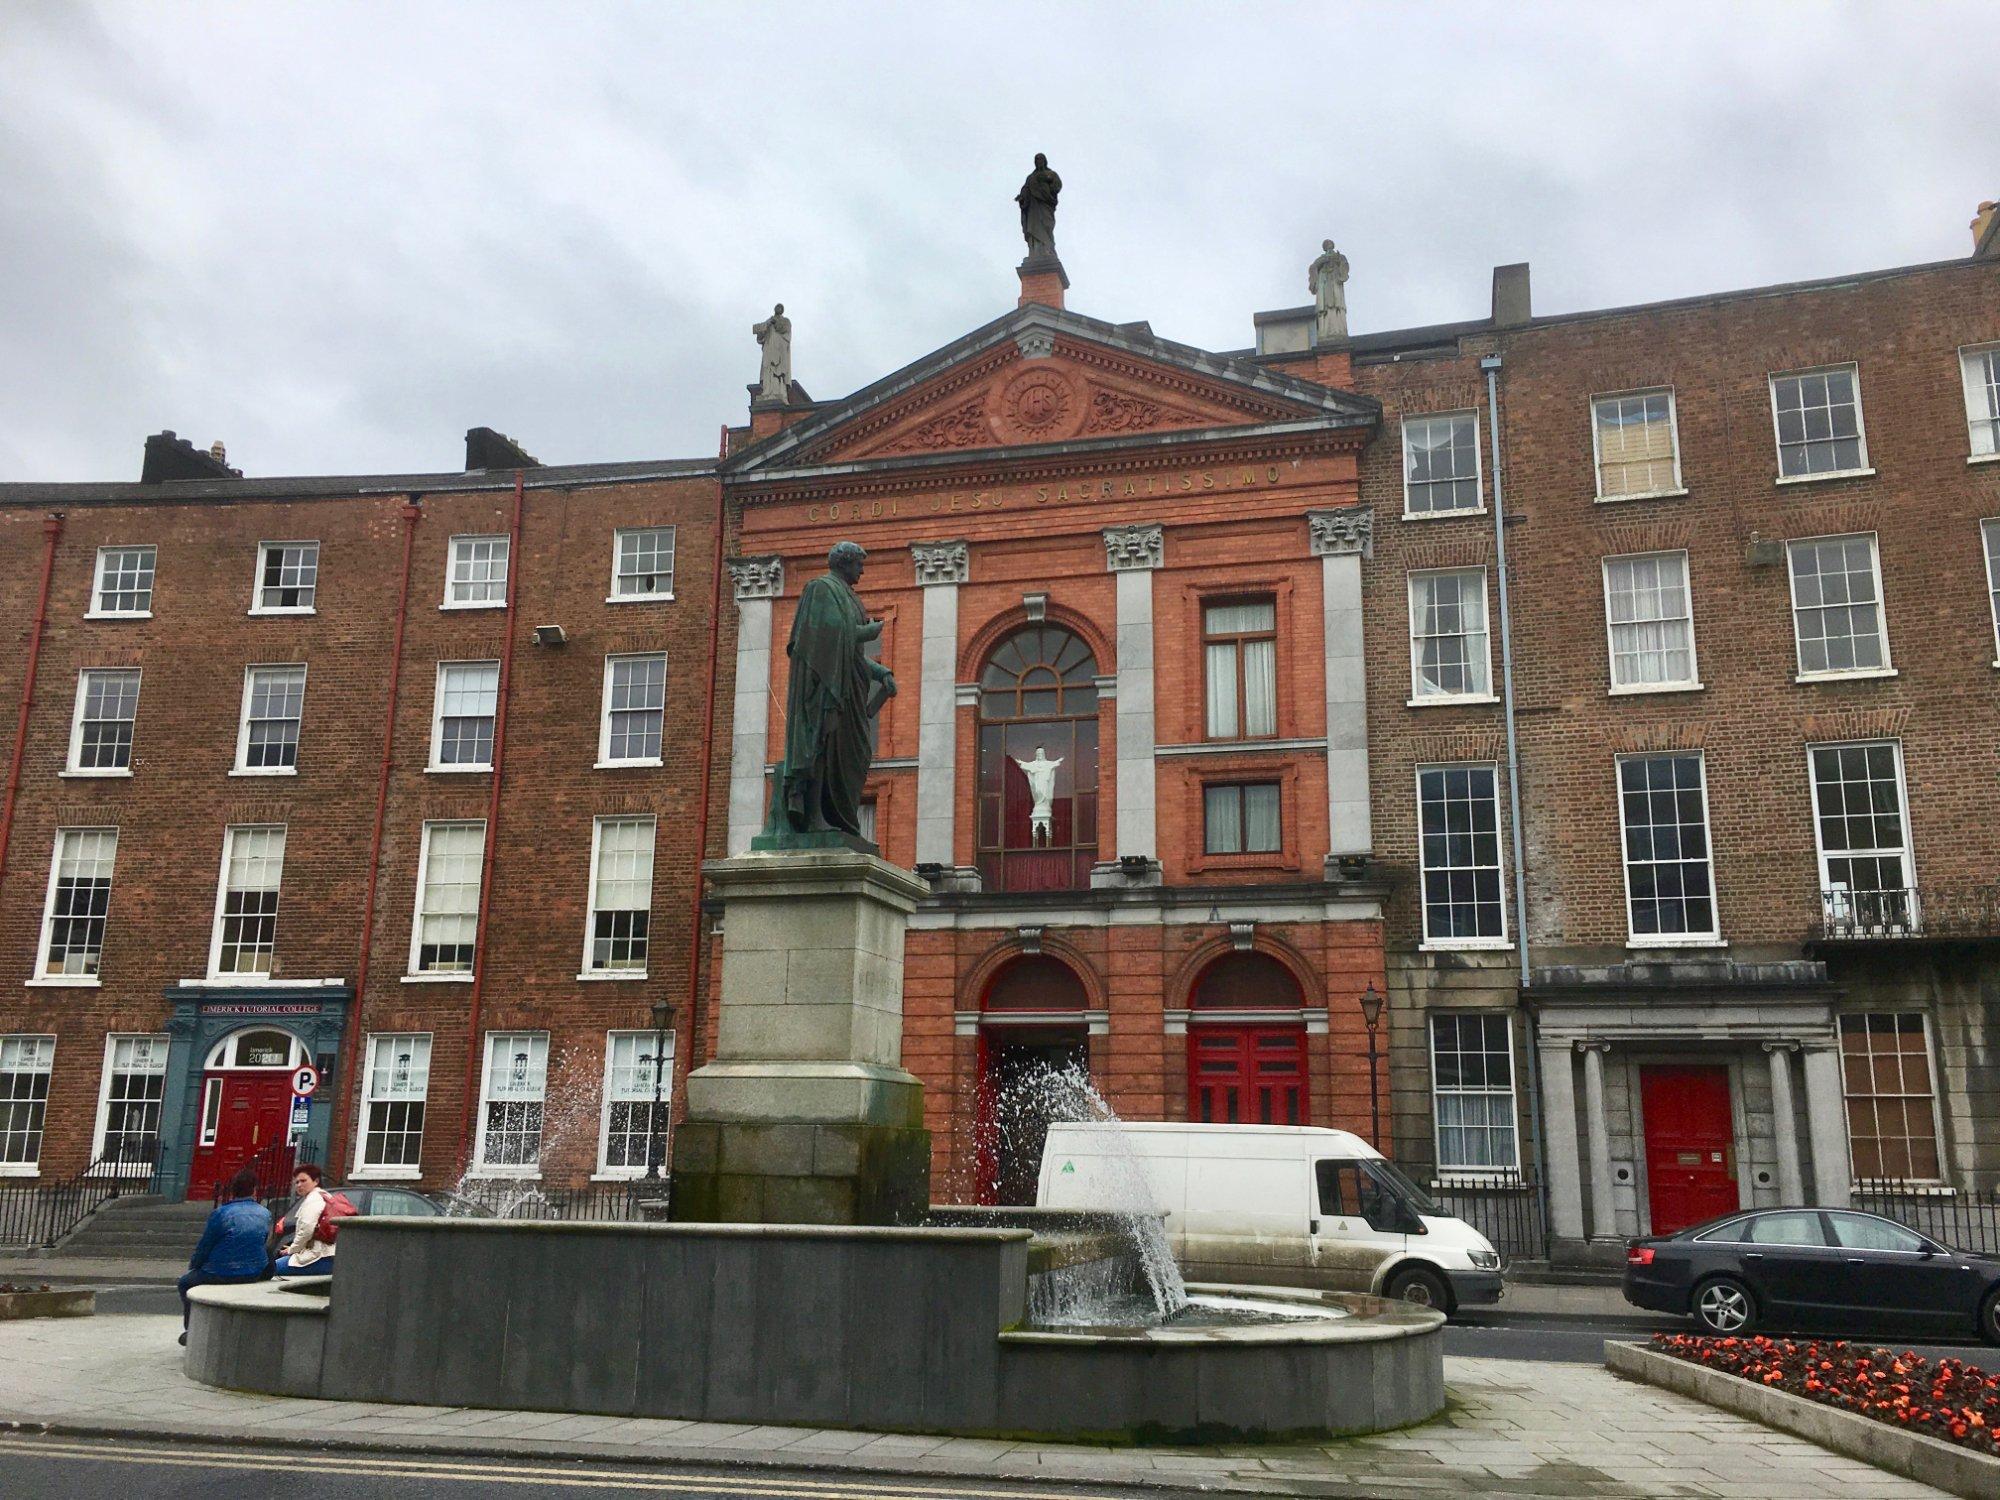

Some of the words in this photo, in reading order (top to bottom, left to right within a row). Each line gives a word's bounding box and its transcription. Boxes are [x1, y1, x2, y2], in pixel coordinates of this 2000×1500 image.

[808, 500, 898, 522] CORDI
[930, 492, 1003, 511] JESU
[1035, 466, 1280, 502] SACRATISSIMO
[203, 1005, 240, 1013] LIMERICK
[242, 1005, 280, 1013] TUTORIAL
[282, 1005, 319, 1013] COLLEGE
[299, 1072, 311, 1089] P
